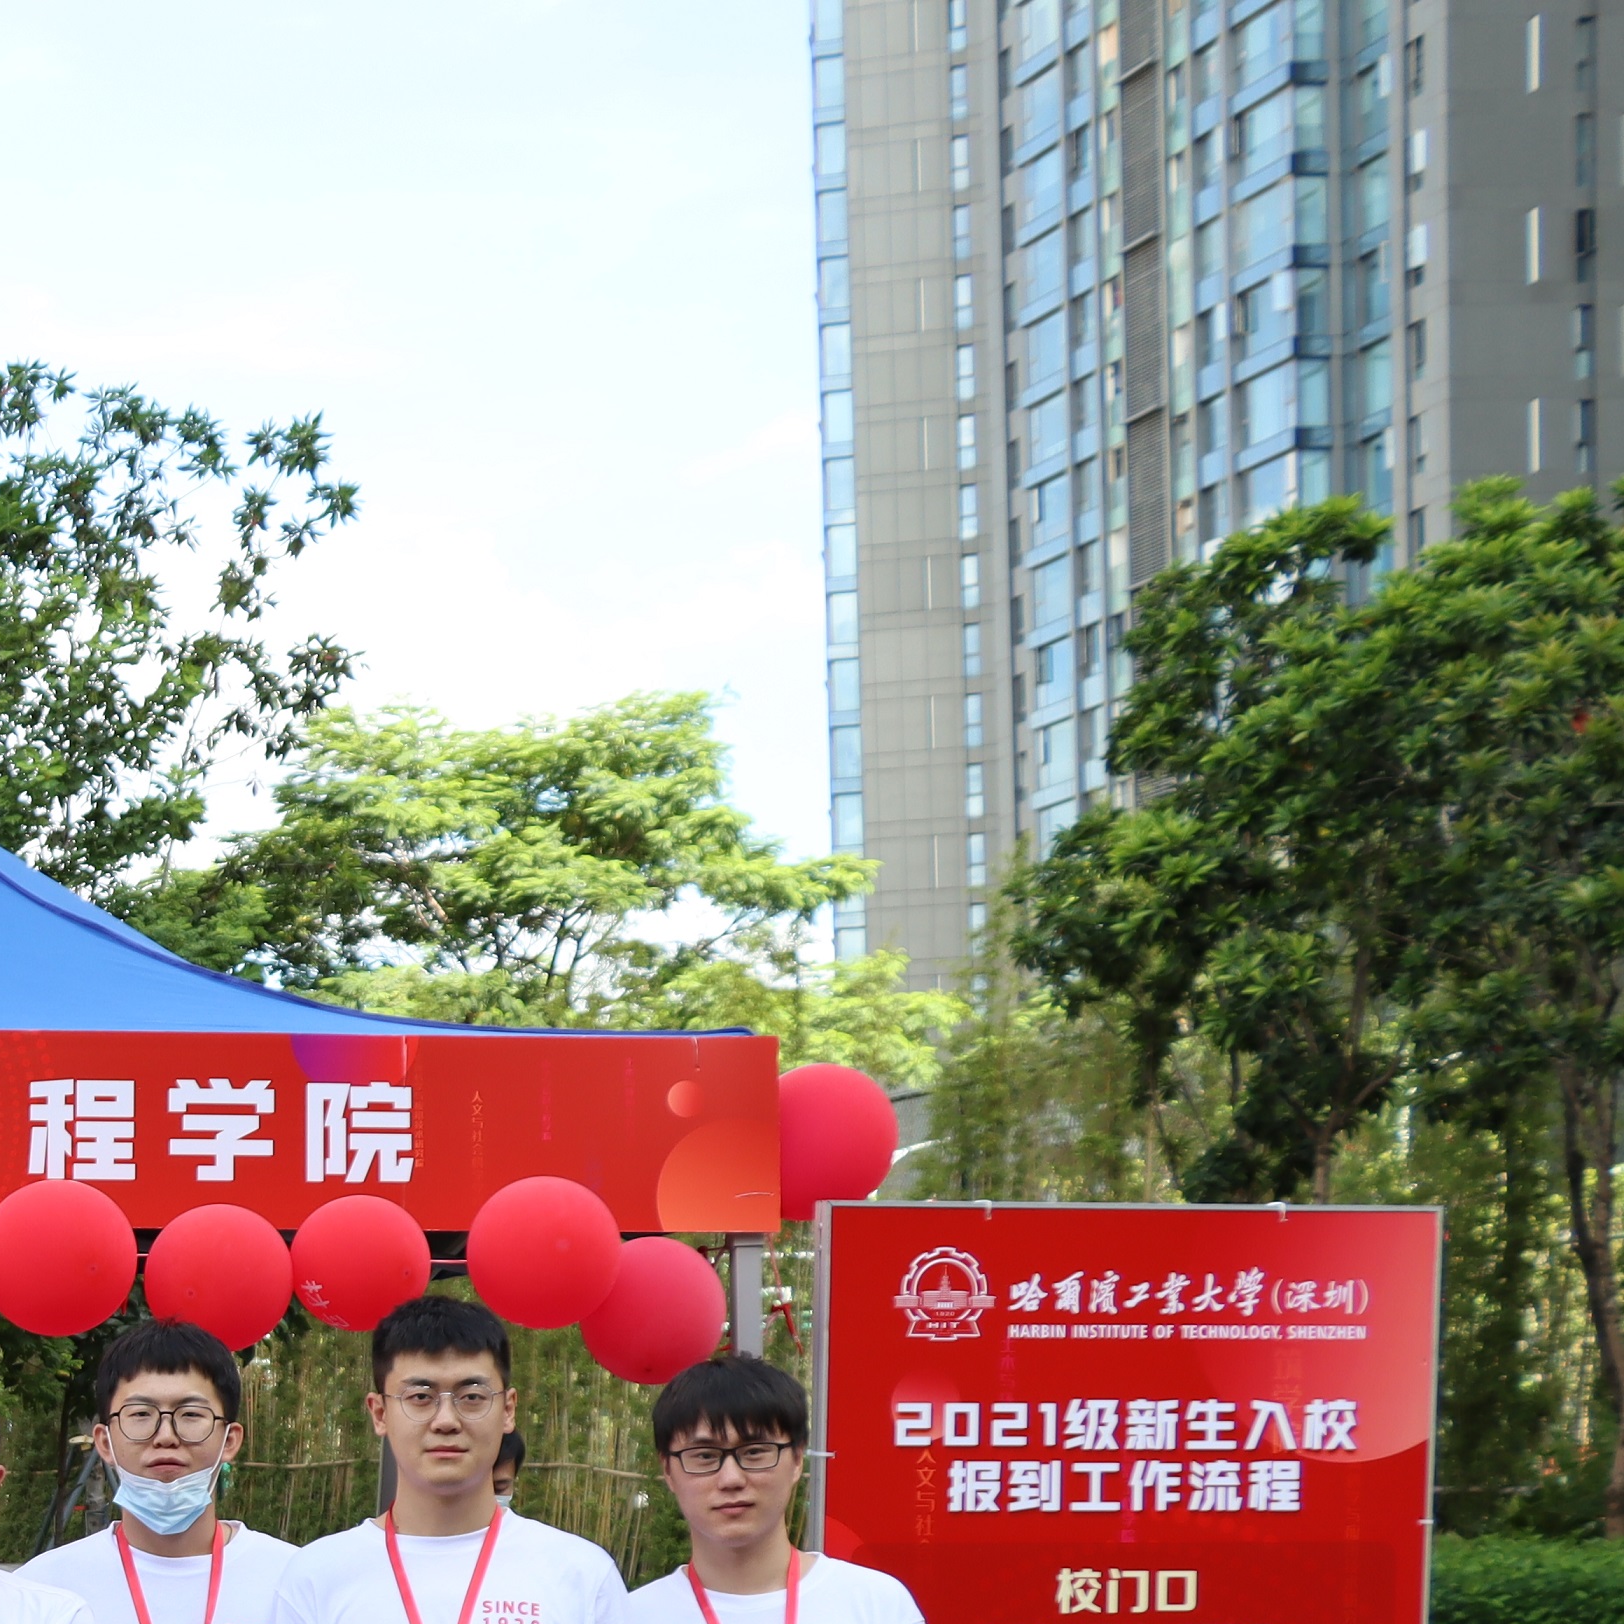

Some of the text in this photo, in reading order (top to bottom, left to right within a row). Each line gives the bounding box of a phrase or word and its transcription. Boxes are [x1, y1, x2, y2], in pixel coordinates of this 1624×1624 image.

[1008, 1324, 1368, 1341] HARBIN INSTITUTE OF TECHNOLOGY, SHENZHEN
[894, 1397, 1358, 1452] 2021级新生入校
[947, 1458, 1302, 1513] 报到工作流程
[481, 1600, 541, 1617] SINCE
[1056, 1566, 1199, 1615] 校门口
